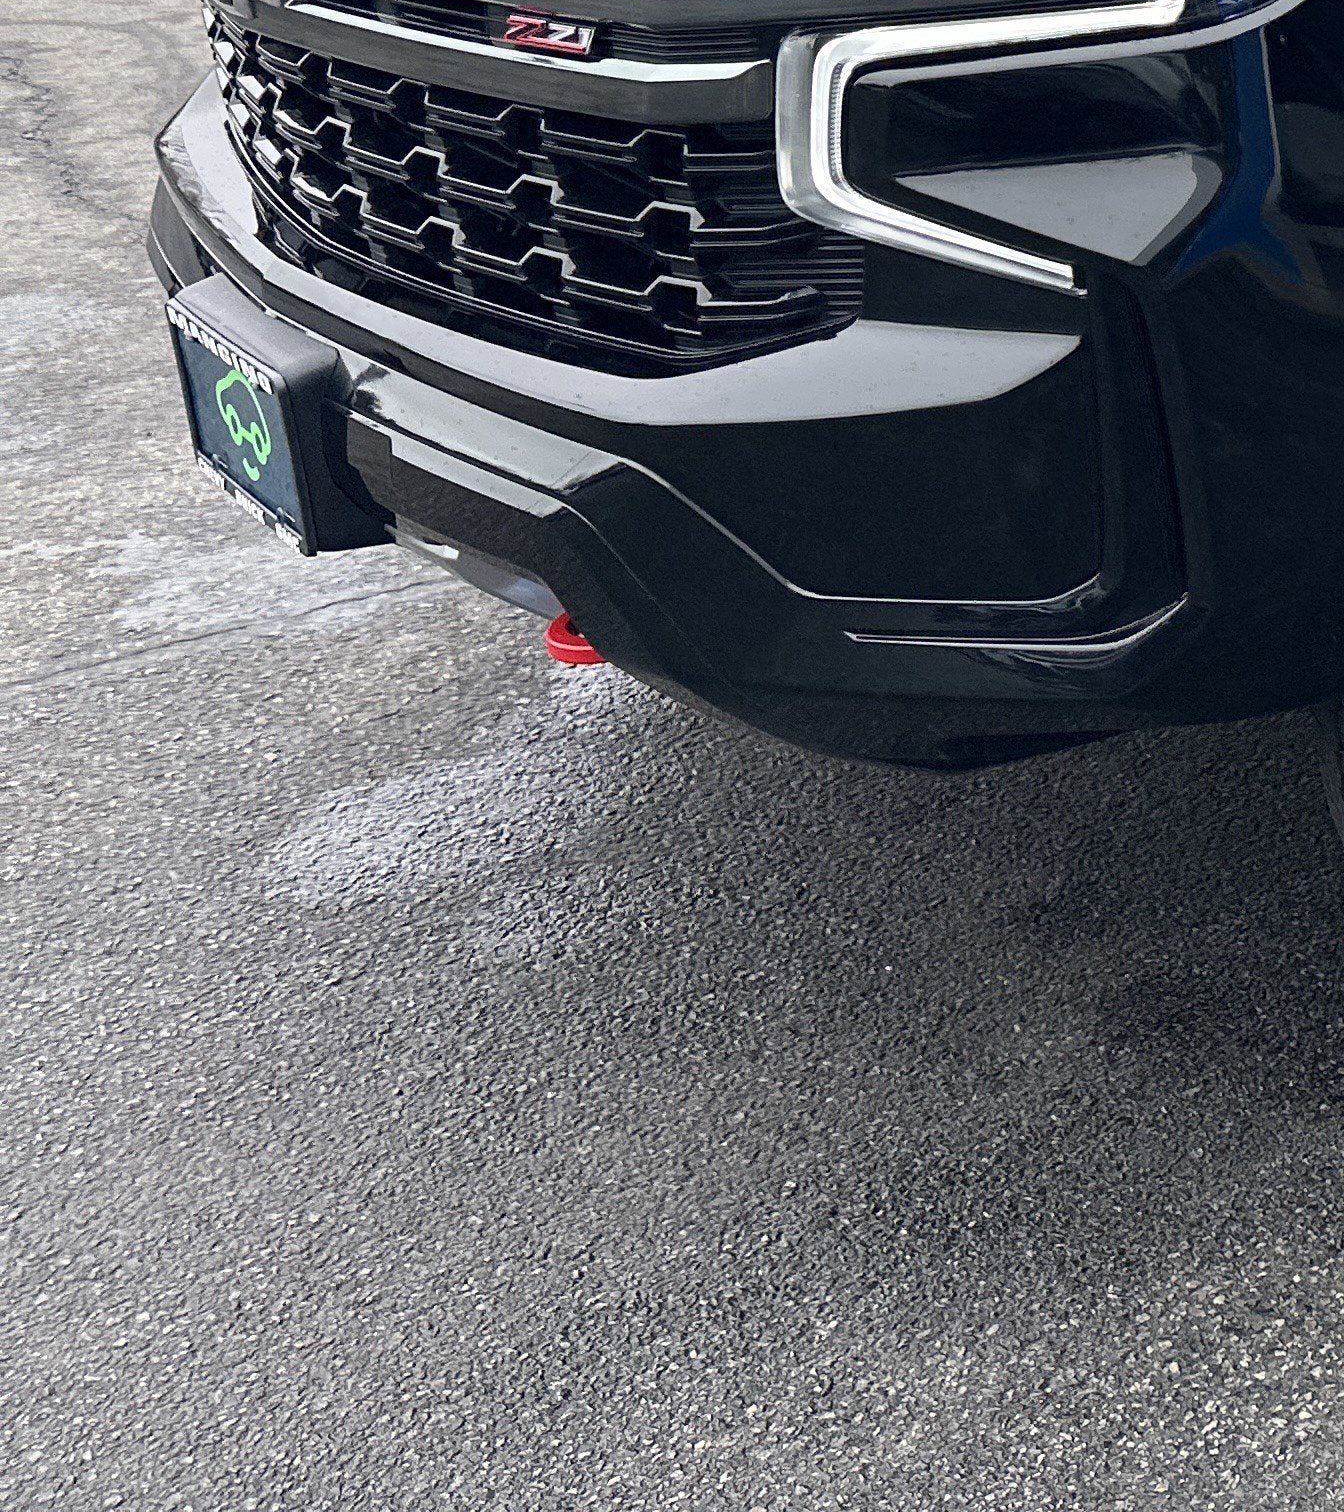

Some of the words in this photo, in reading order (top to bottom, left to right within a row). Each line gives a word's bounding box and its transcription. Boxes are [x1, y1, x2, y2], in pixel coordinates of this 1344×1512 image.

[504, 14, 596, 55] Z71
[235, 489, 265, 526] BUICK
[275, 522, 301, 554] GMC
